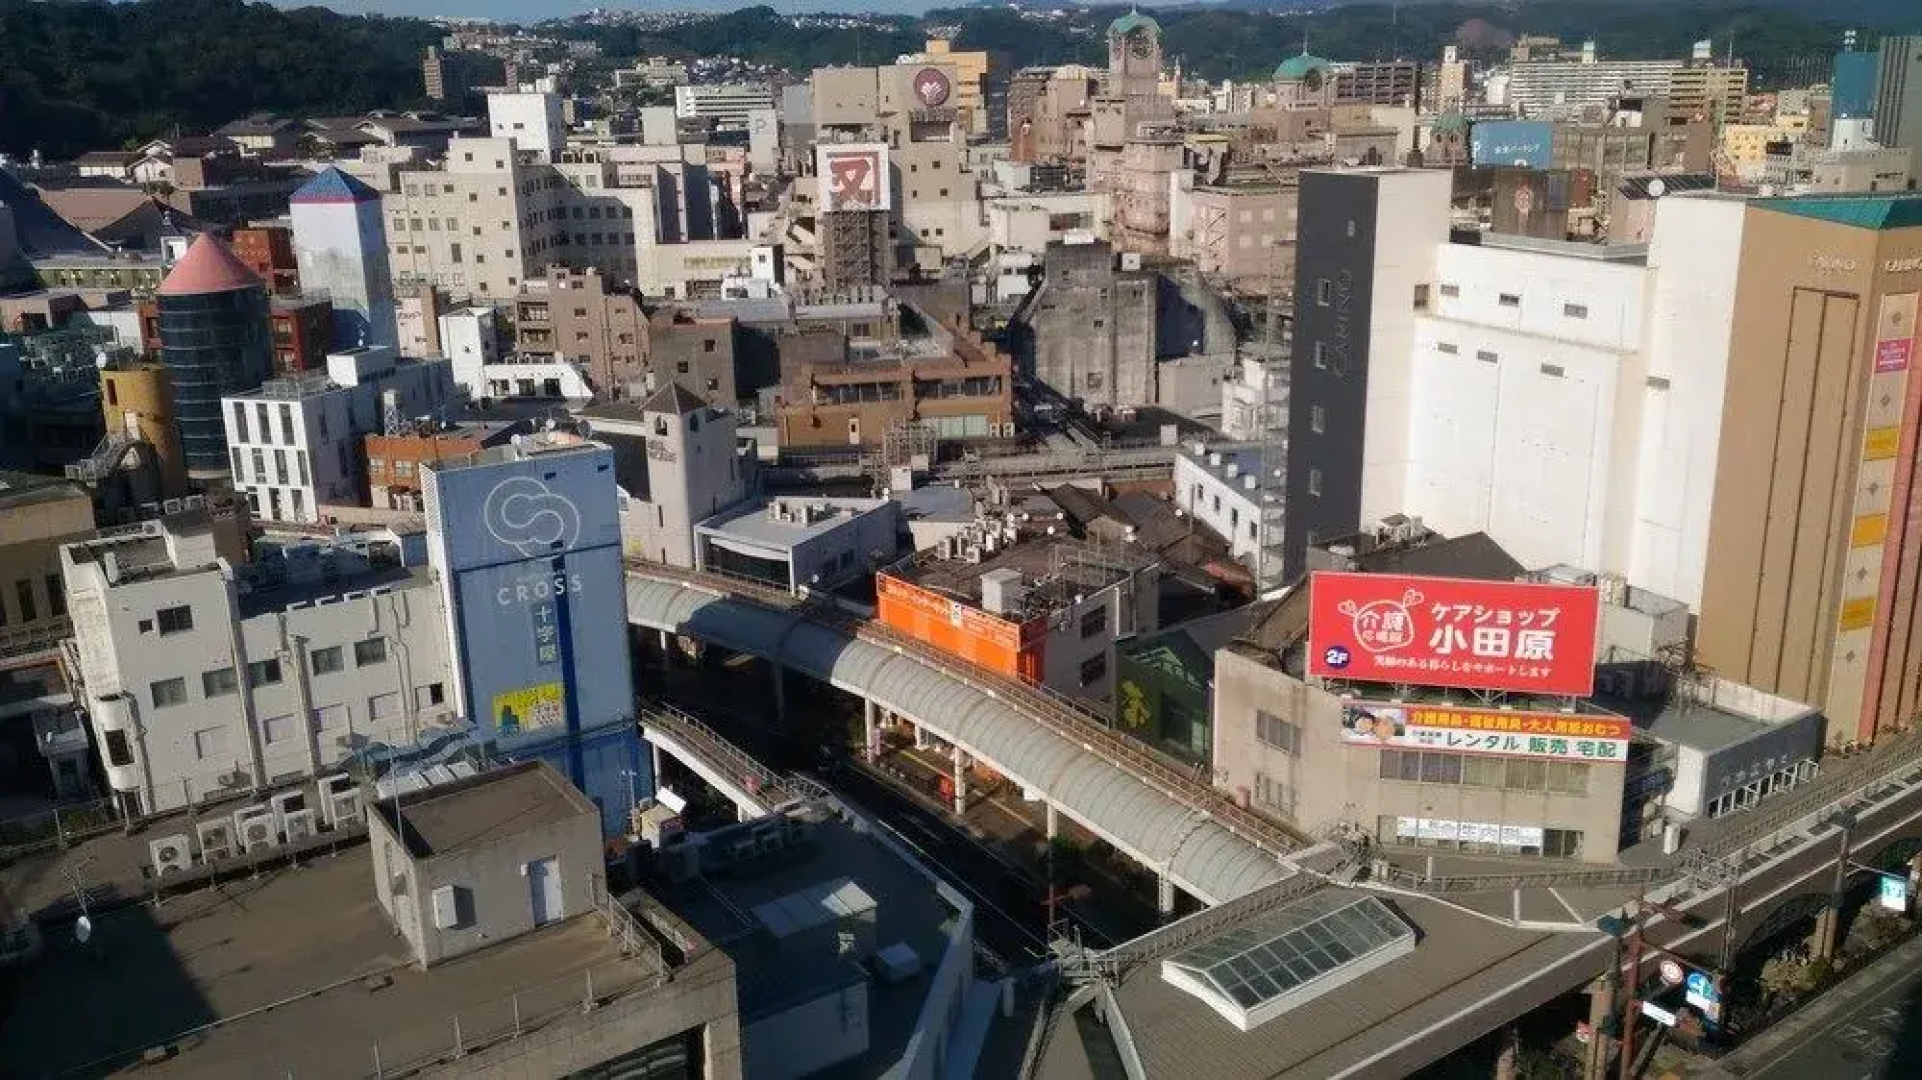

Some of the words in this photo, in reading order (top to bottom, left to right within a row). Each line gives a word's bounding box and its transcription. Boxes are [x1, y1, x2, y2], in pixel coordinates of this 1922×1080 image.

[497, 573, 583, 606] CROSS
[1430, 603, 1562, 628] ケアショップ
[1428, 624, 1557, 660] 小田原
[1325, 649, 1348, 664] 2F
[1446, 731, 1521, 751] レンタル
[1528, 736, 1569, 755] 販売
[1576, 740, 1618, 759] 宅配
